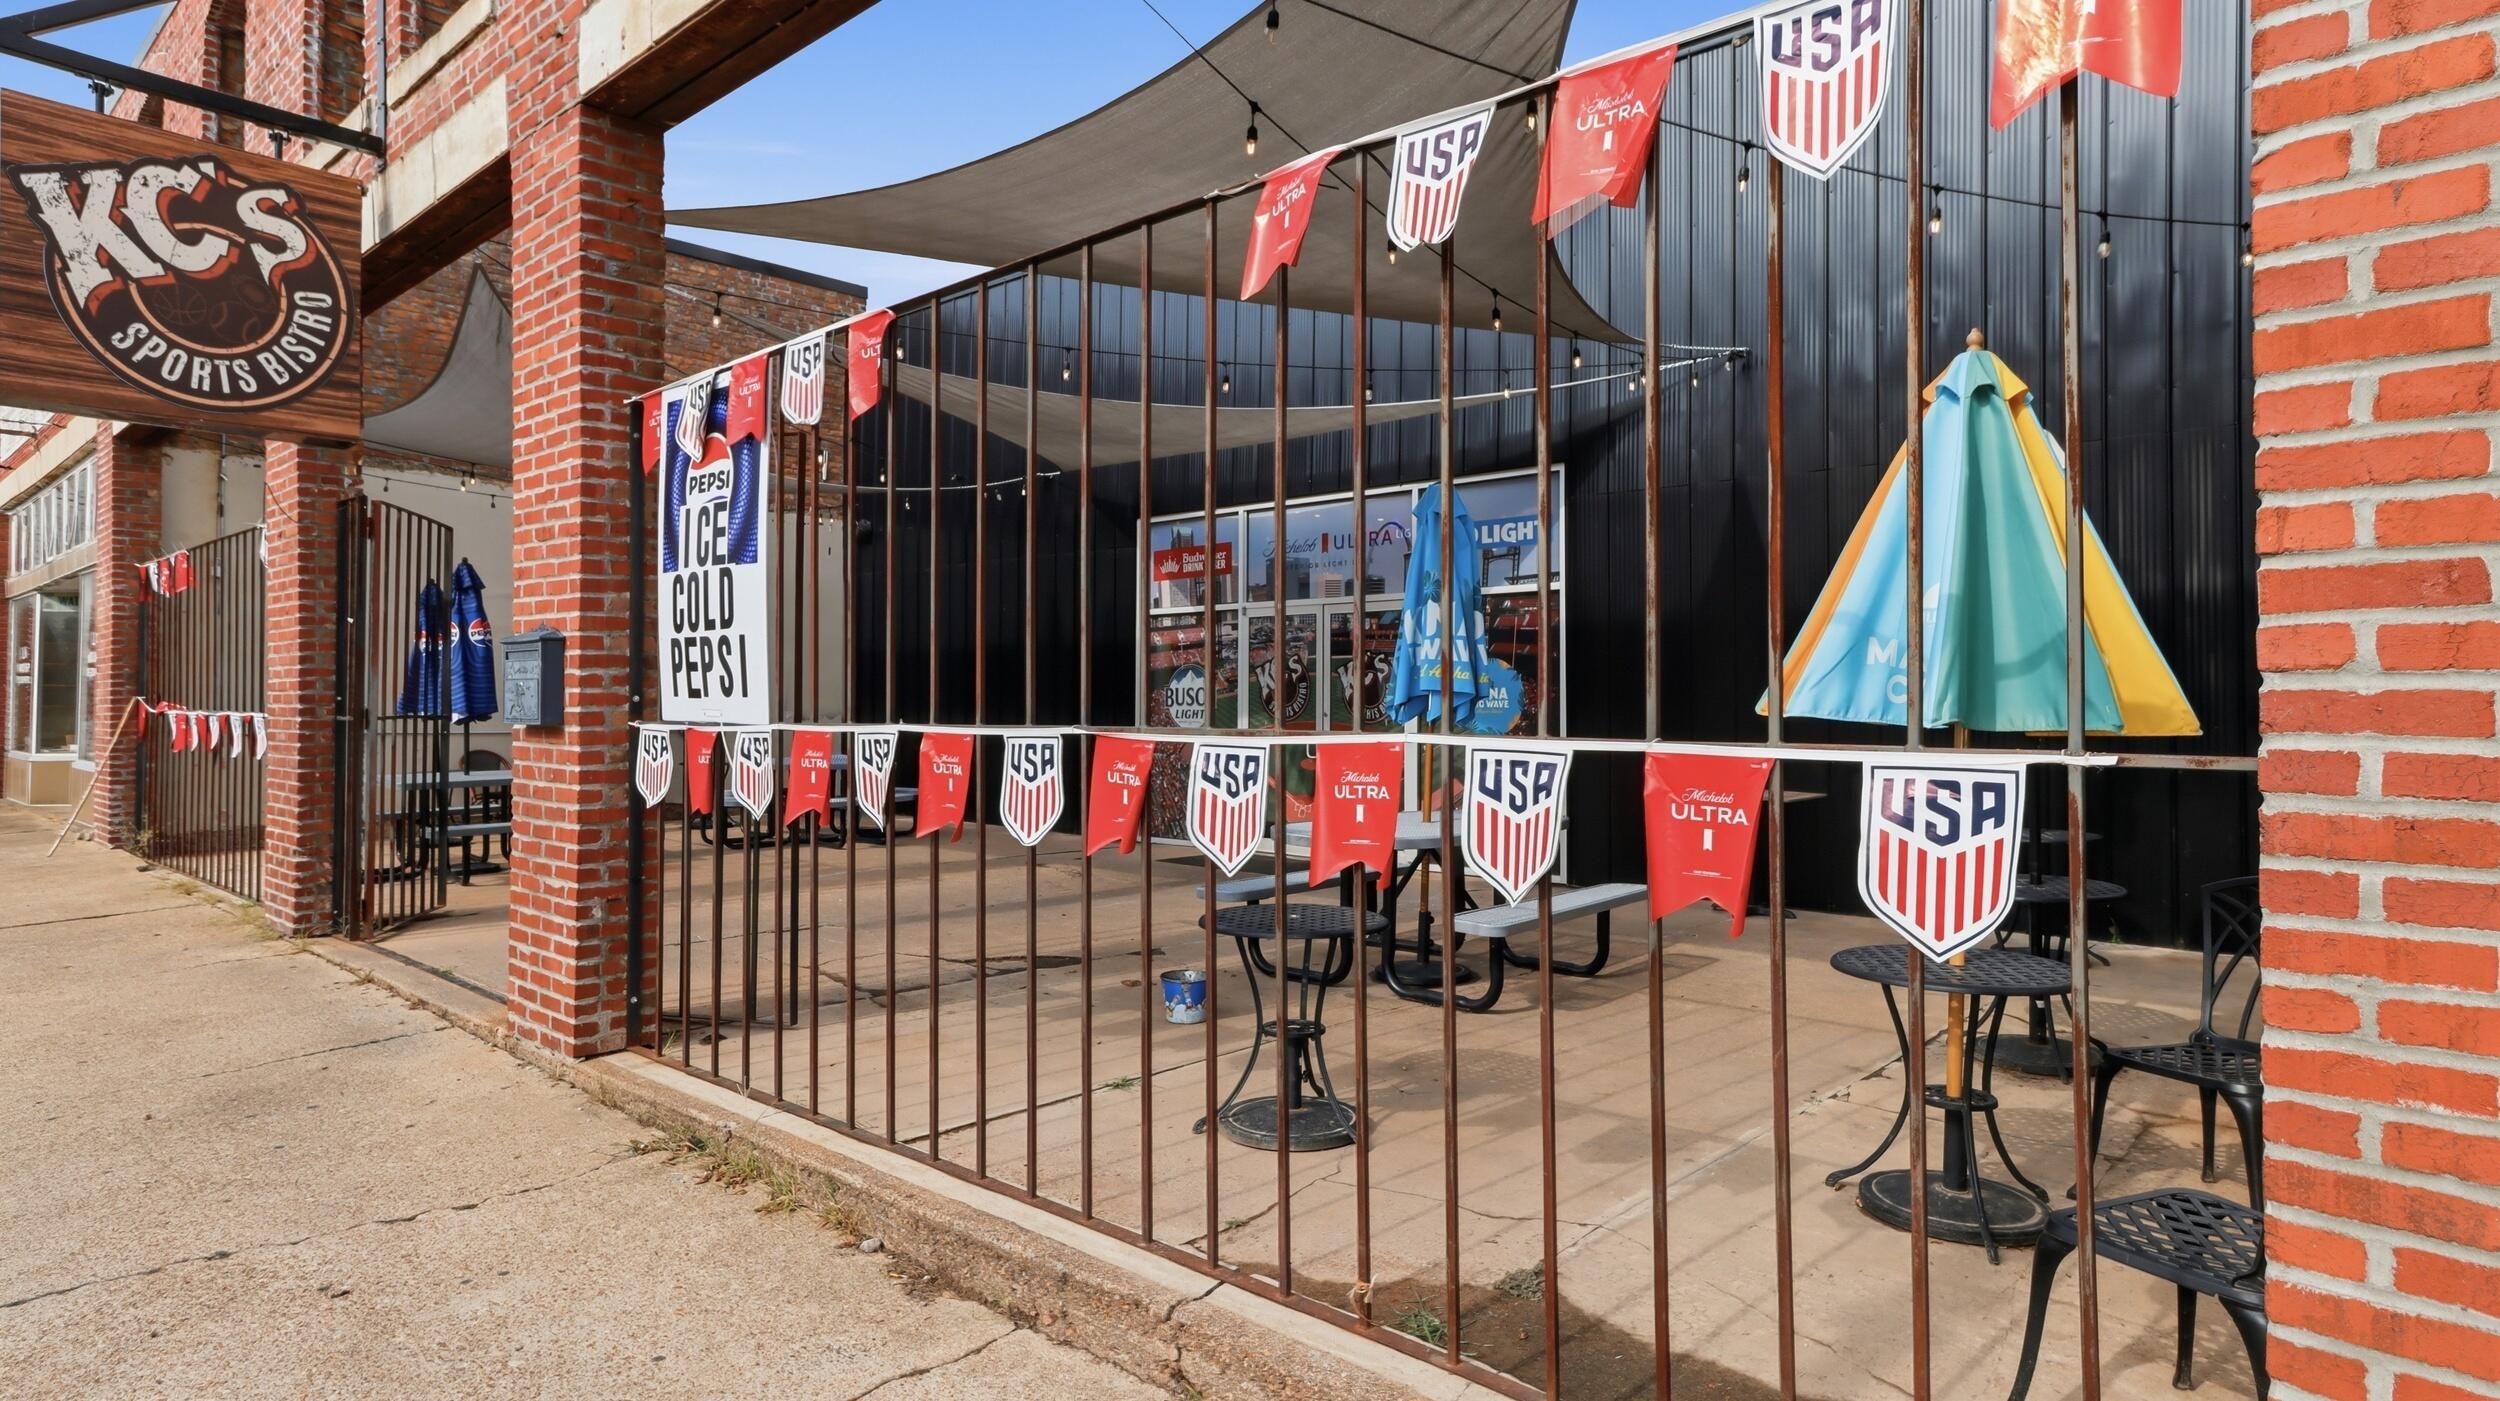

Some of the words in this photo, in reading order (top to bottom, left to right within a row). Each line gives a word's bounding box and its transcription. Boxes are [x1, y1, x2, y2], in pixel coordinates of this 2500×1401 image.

[1771, 0, 1882, 72] USA
[1576, 100, 1649, 131] ULTRA
[1407, 120, 1483, 182] USA
[1272, 183, 1307, 217] ULTRA
[111, 322, 258, 394] SPORTS
[258, 291, 333, 386] BISTRO
[861, 344, 881, 359] ULT
[791, 342, 821, 378] USA
[689, 469, 730, 496] PEPSI
[684, 501, 728, 569] ICE
[1334, 531, 1393, 550] ULRA
[672, 567, 734, 634] COLD
[671, 634, 748, 699] PEPSI
[1165, 687, 1205, 708] BUSC
[1486, 700, 1510, 708] WAVE
[643, 734, 669, 762] USA
[697, 755, 712, 764] ULT
[740, 737, 768, 767] USA
[801, 757, 829, 769] ULTRA
[862, 738, 890, 773] USA
[1011, 743, 1054, 783] USA
[933, 761, 962, 776] ULTRA
[1107, 771, 1142, 787] ULTRA
[1202, 752, 1260, 799] USA
[1341, 771, 1380, 783] Michelob
[1334, 784, 1391, 800] ULTRA
[1479, 758, 1557, 815] USA
[1682, 787, 1735, 804] Michelob
[1671, 803, 1750, 826] ULTRA
[1881, 778, 2006, 847] USA
